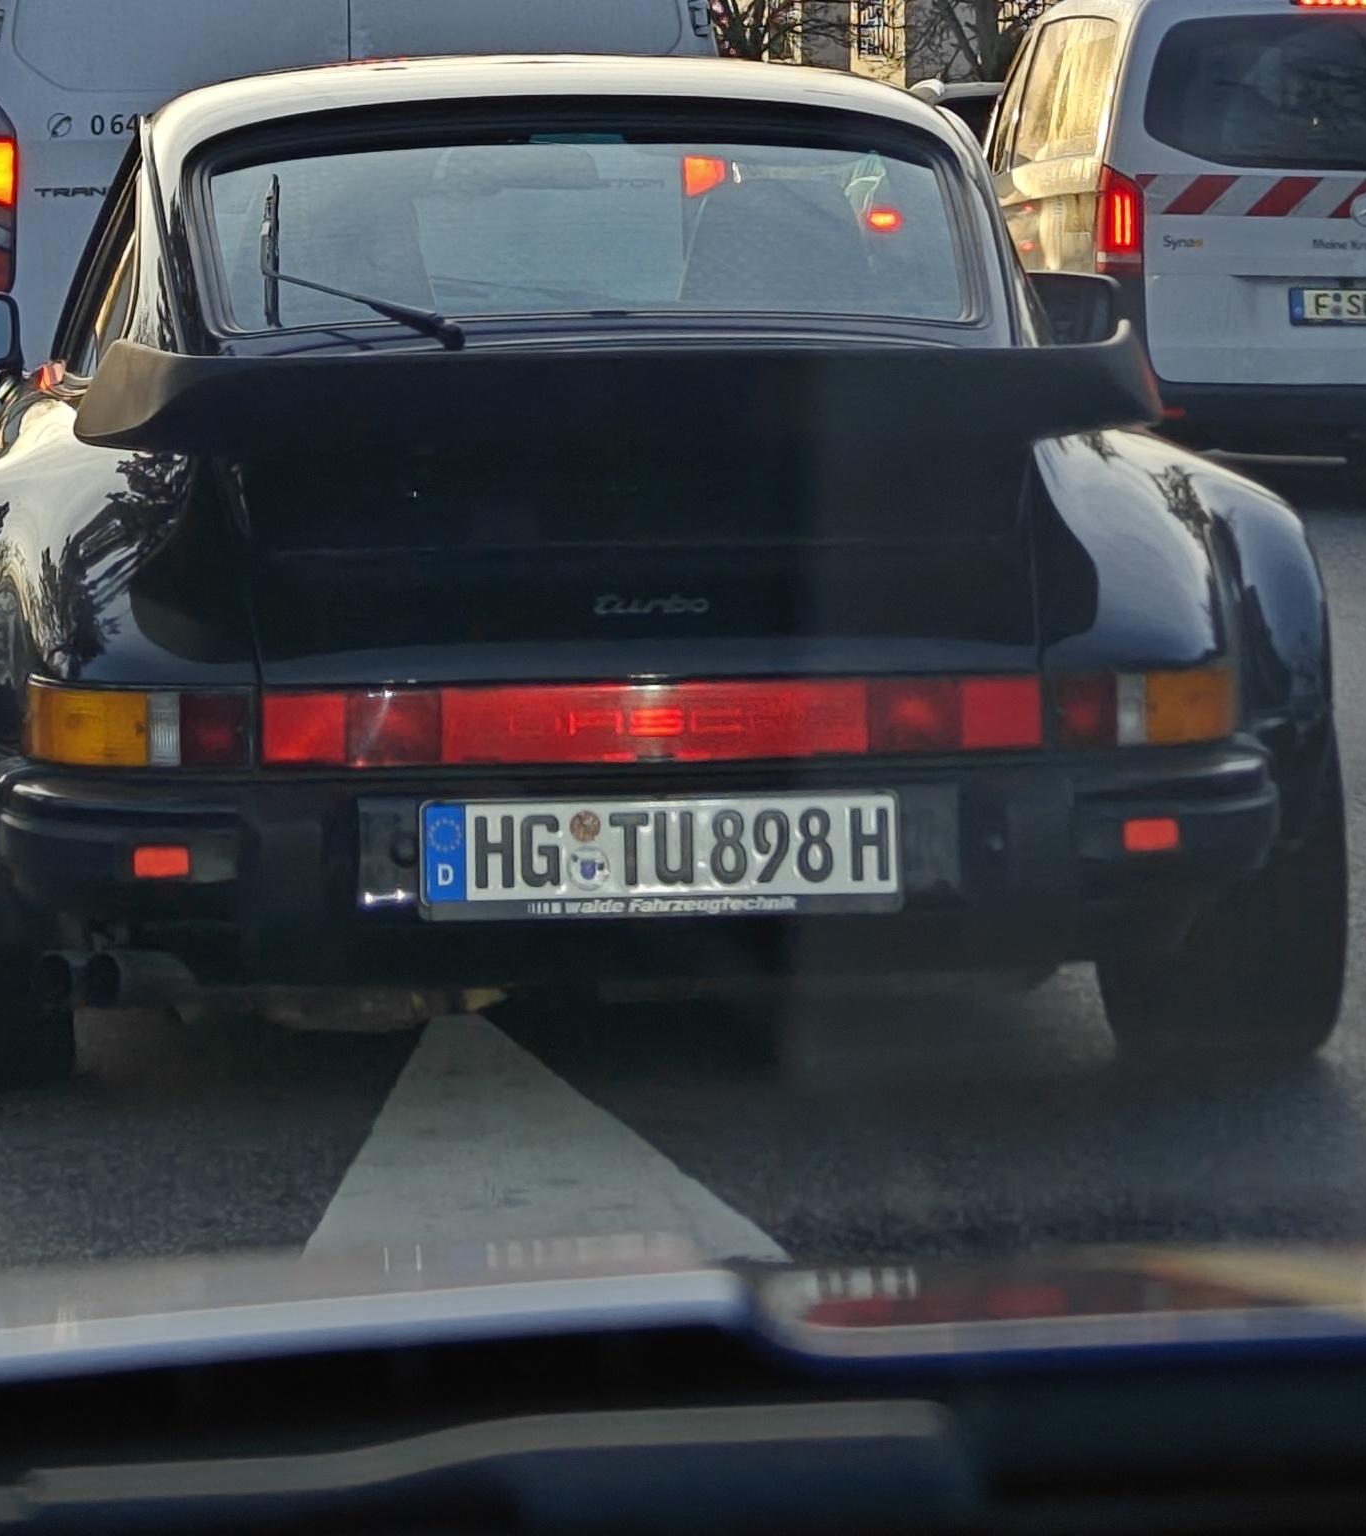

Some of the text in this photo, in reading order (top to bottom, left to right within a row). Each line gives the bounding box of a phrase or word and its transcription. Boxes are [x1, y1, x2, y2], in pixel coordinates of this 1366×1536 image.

[1314, 293, 1331, 316] F
[473, 813, 561, 889] HG
[609, 810, 695, 886] TU
[437, 864, 454, 887] D
[628, 896, 797, 915] Fahrzeugtechnik
